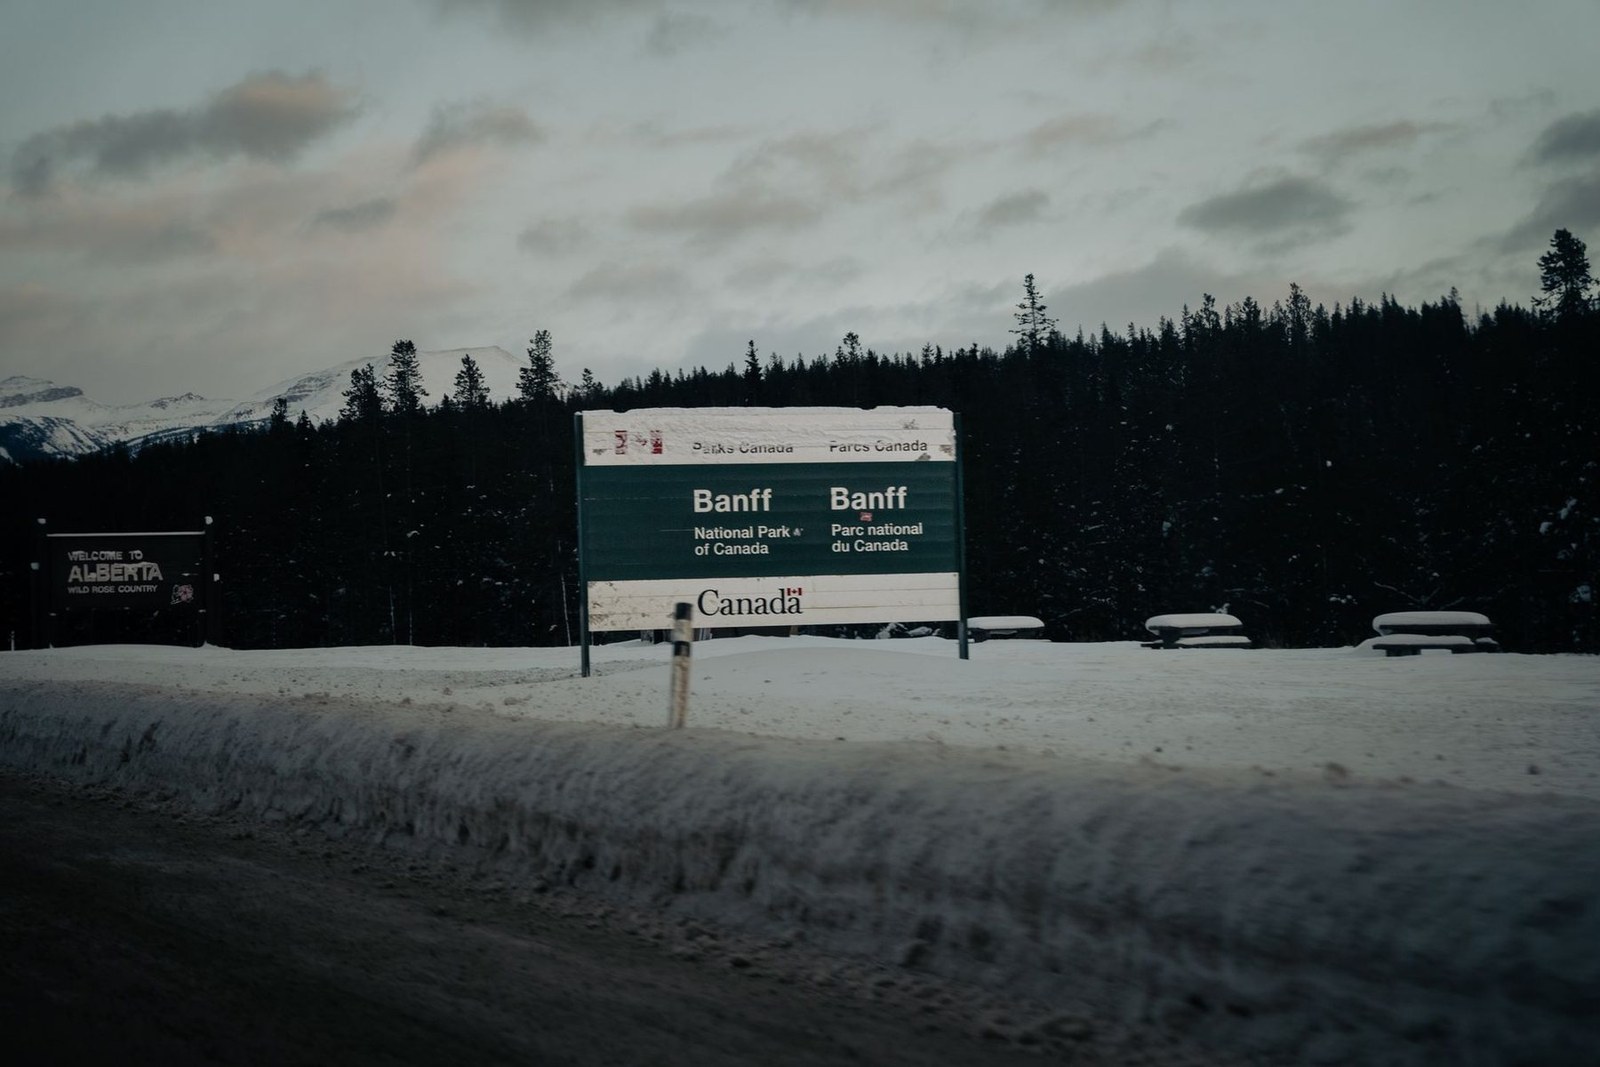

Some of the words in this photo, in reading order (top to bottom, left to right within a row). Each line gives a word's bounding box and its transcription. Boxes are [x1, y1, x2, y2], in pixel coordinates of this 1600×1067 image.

[875, 439, 928, 452] Canada
[694, 488, 773, 513] Banff
[830, 486, 908, 511] Banff
[694, 526, 753, 540] National
[758, 526, 790, 538] Park
[831, 523, 864, 536] Parc
[867, 522, 923, 536] national
[694, 542, 710, 556] of
[714, 542, 769, 555] Canada
[832, 540, 850, 552] du
[854, 539, 908, 552] Canada
[67, 550, 123, 561] WELCOME
[130, 549, 143, 560] TO
[68, 562, 164, 583] ALBERTA
[68, 586, 90, 594] WILD
[92, 585, 115, 593] ROSE
[118, 584, 158, 593] COUNTRY
[697, 588, 803, 616] Canada
